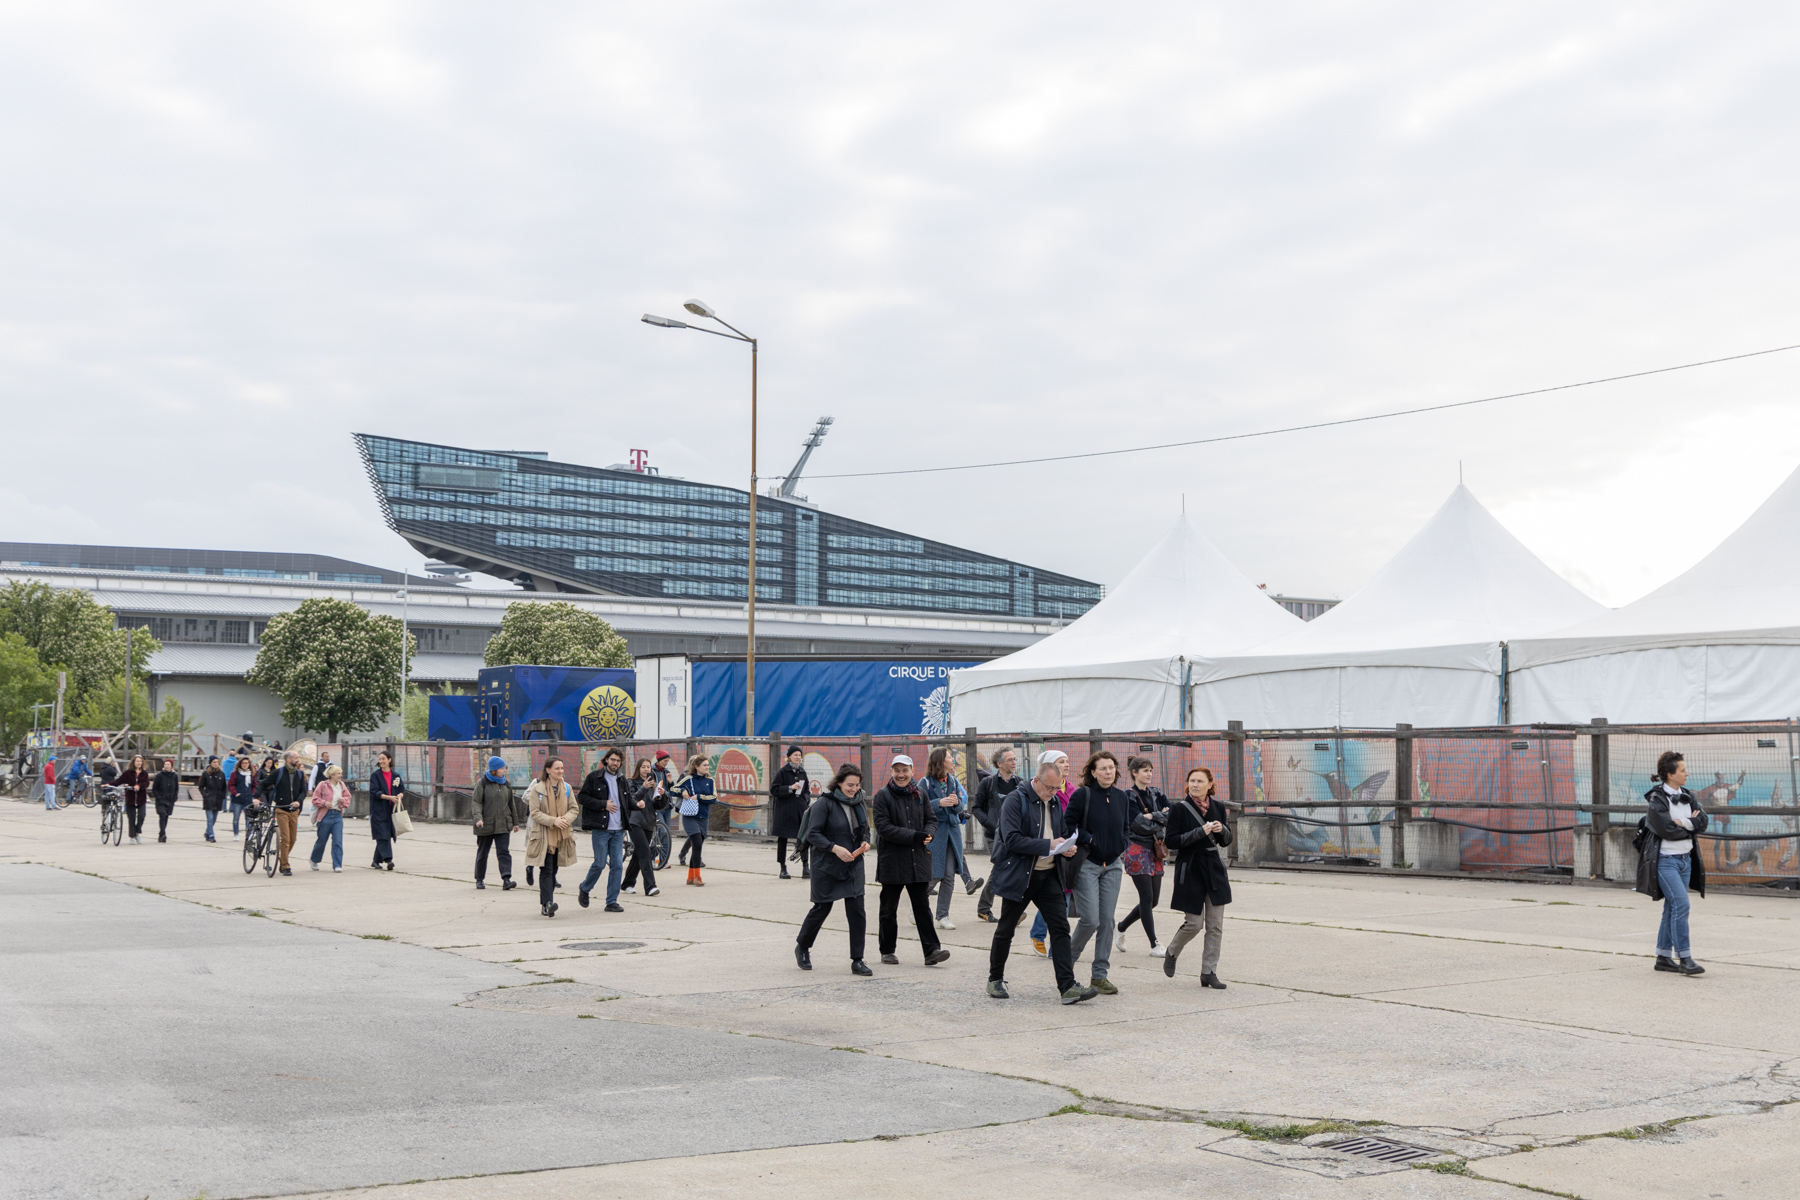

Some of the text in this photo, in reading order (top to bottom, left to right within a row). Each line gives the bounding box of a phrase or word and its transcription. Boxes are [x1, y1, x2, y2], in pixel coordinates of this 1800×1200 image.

[630, 449, 648, 472] T
[889, 666, 935, 682] CIRQUE
[718, 772, 756, 799] LUZIA
